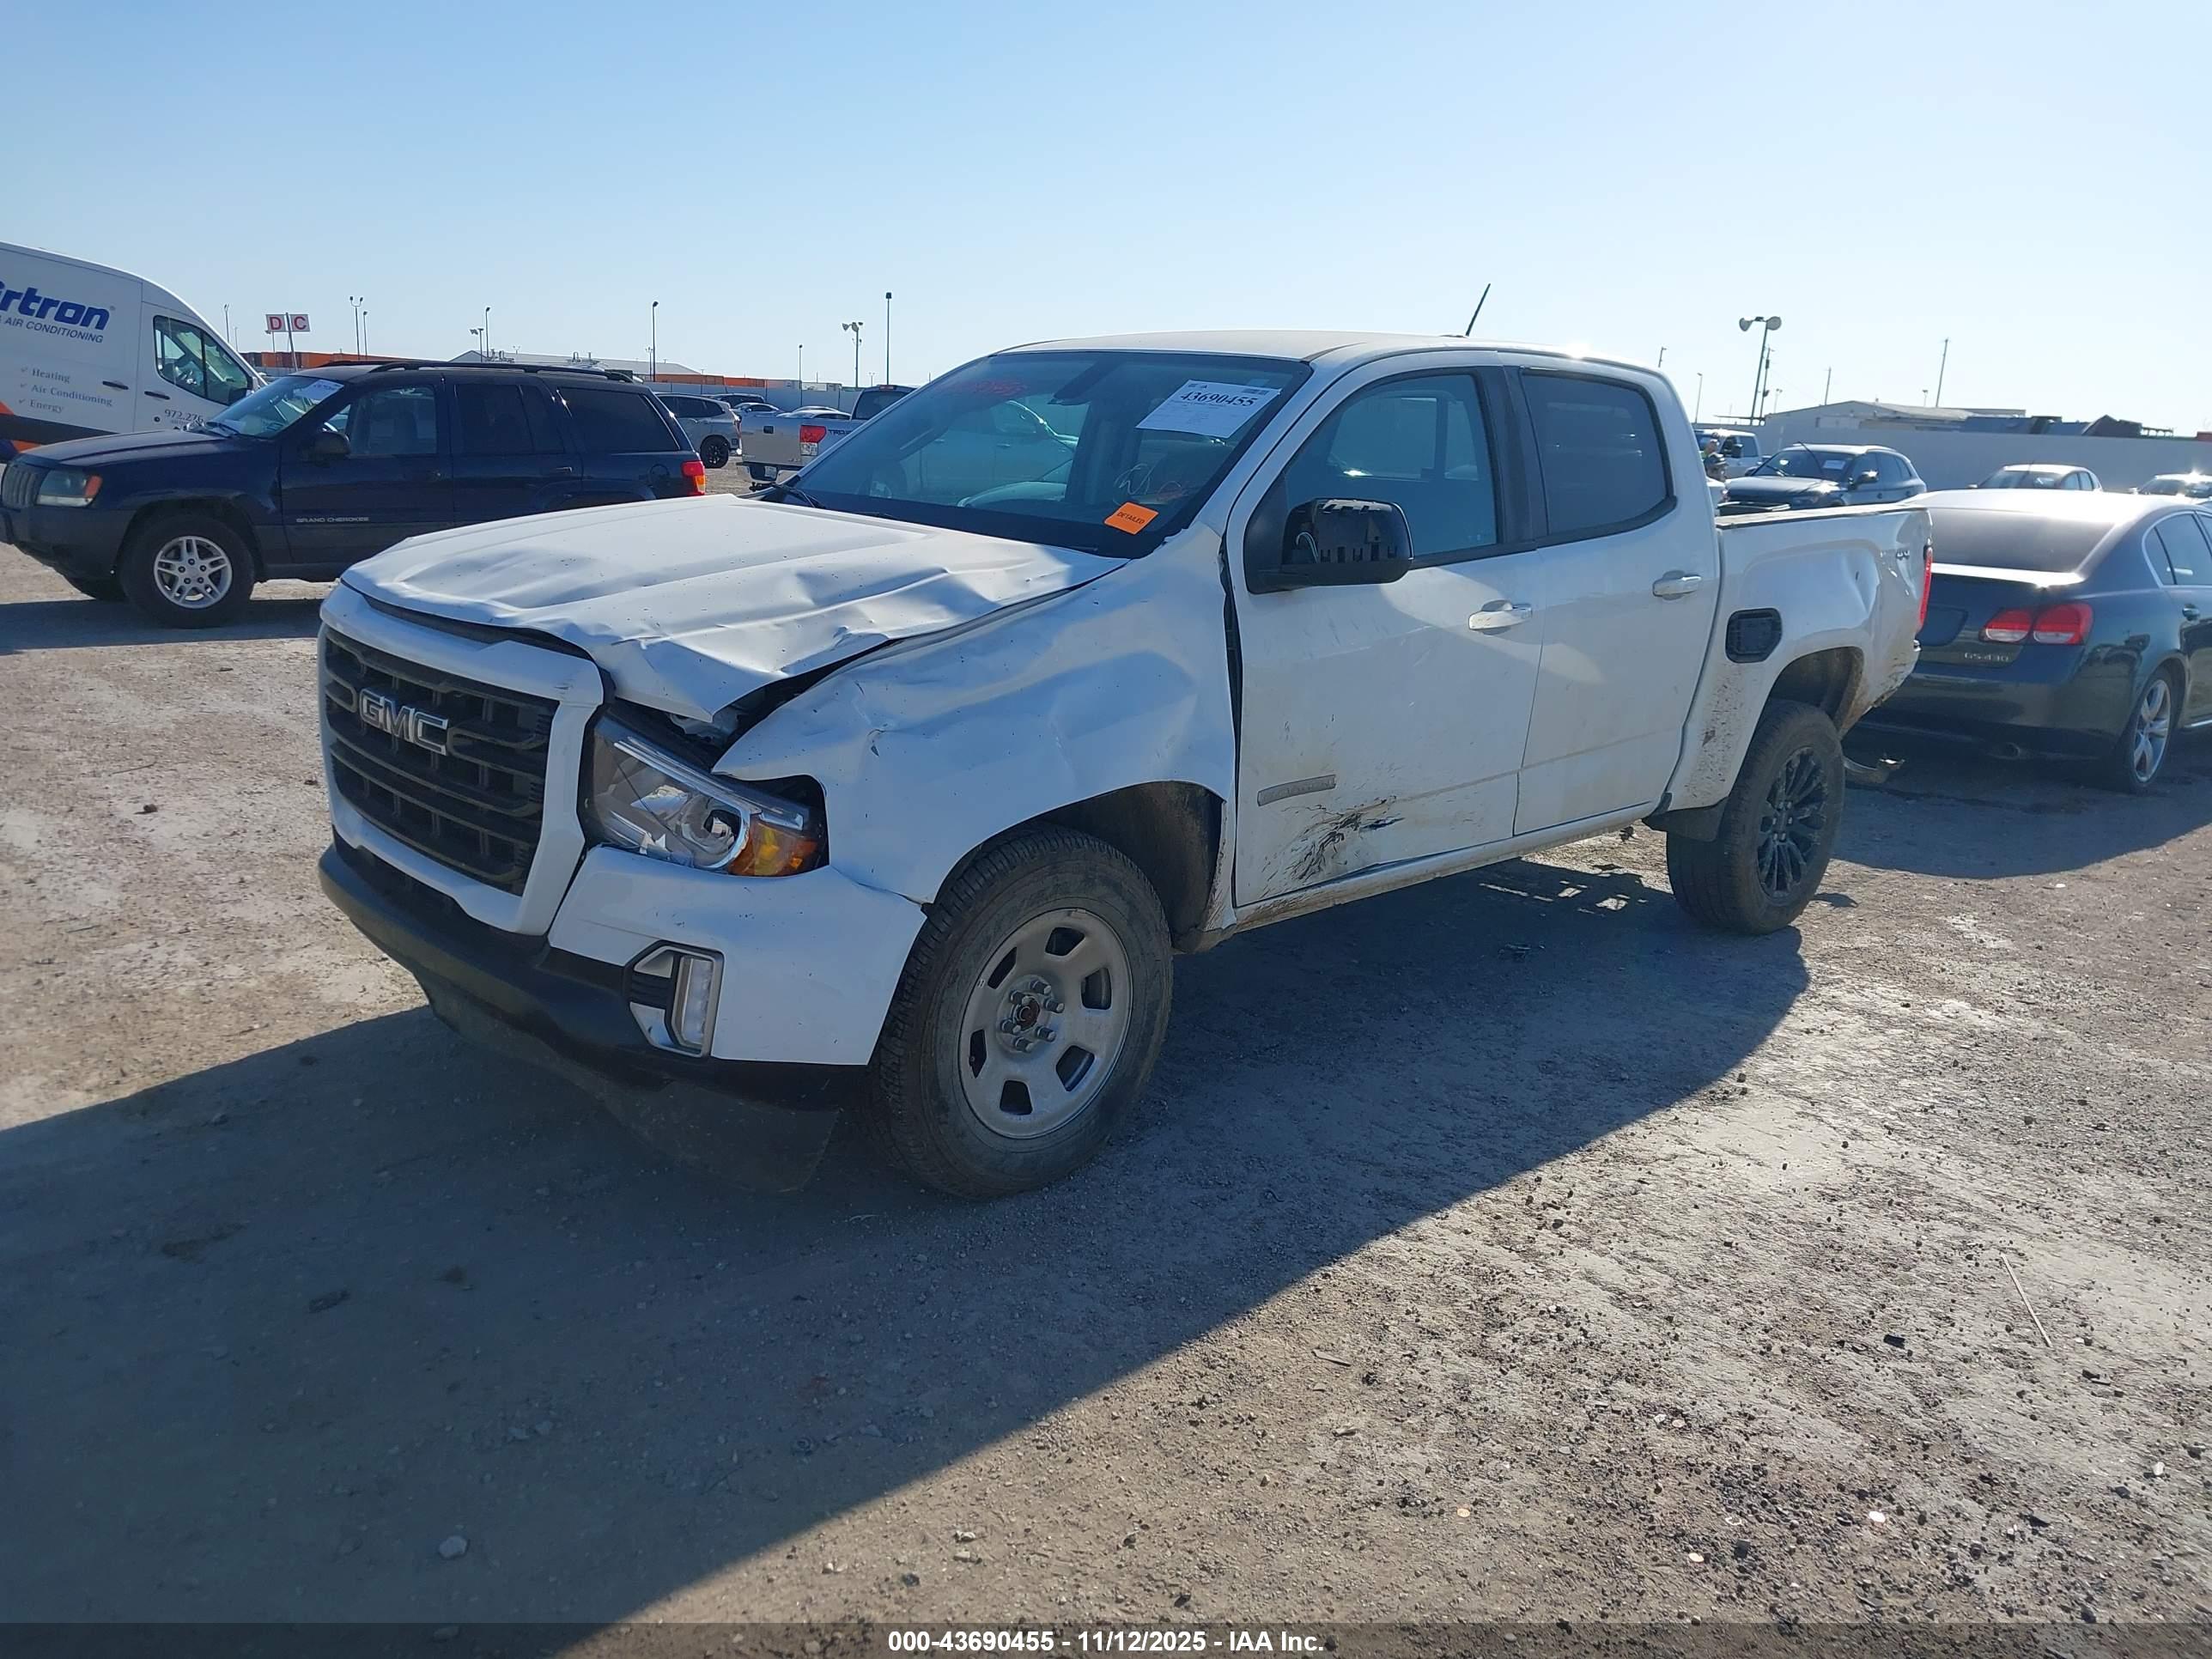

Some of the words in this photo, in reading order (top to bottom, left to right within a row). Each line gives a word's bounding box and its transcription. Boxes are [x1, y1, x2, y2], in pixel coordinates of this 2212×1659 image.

[5, 317, 24, 327] AIR
[26, 320, 104, 343] CONDITIONING
[269, 316, 282, 330] D
[294, 316, 307, 330] C
[32, 368, 70, 384] Heating
[31, 385, 47, 394] Air
[50, 387, 112, 406] Conditioning
[1181, 391, 1258, 407] 43690455
[30, 398, 64, 414] Energy
[1117, 512, 1146, 525] DETAILED
[359, 688, 448, 757] GMC
